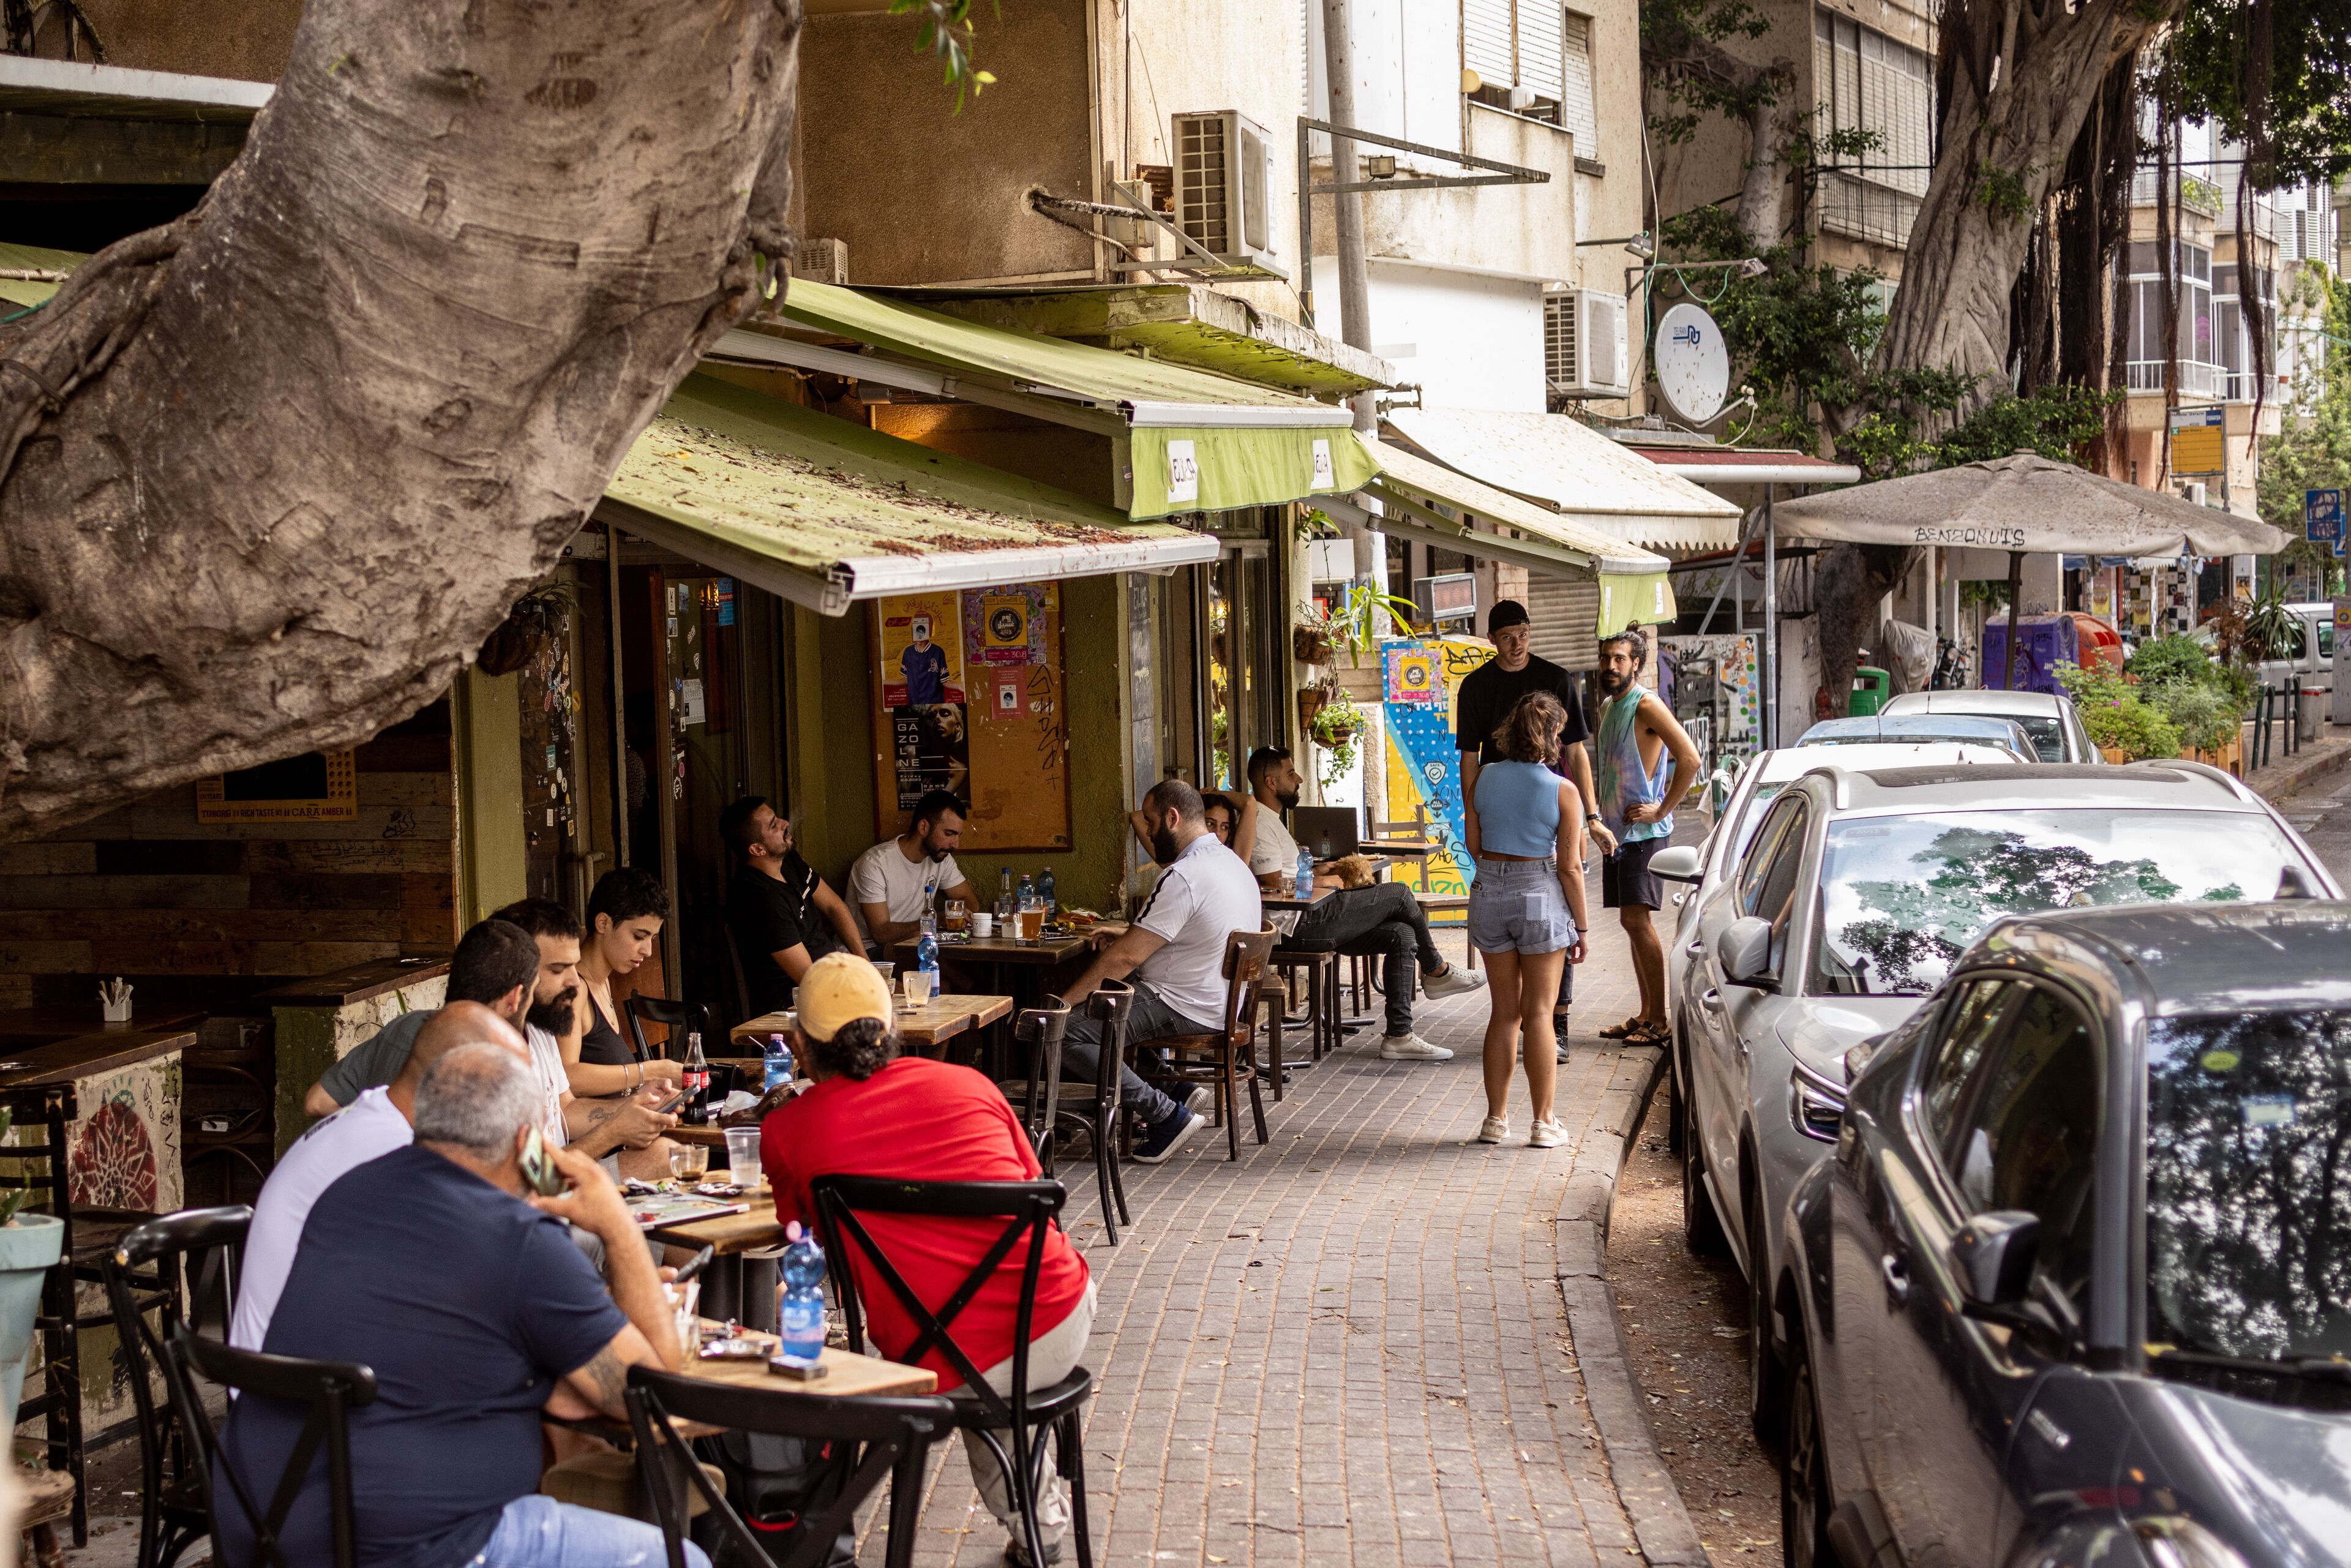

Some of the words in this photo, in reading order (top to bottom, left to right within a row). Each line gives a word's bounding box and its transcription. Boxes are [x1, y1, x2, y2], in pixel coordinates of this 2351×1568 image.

[201, 809, 231, 818] TUBORG
[240, 809, 255, 817] RICH
[256, 808, 275, 817] TASTE
[291, 808, 320, 816] CARA
[321, 807, 344, 816] AMBER
